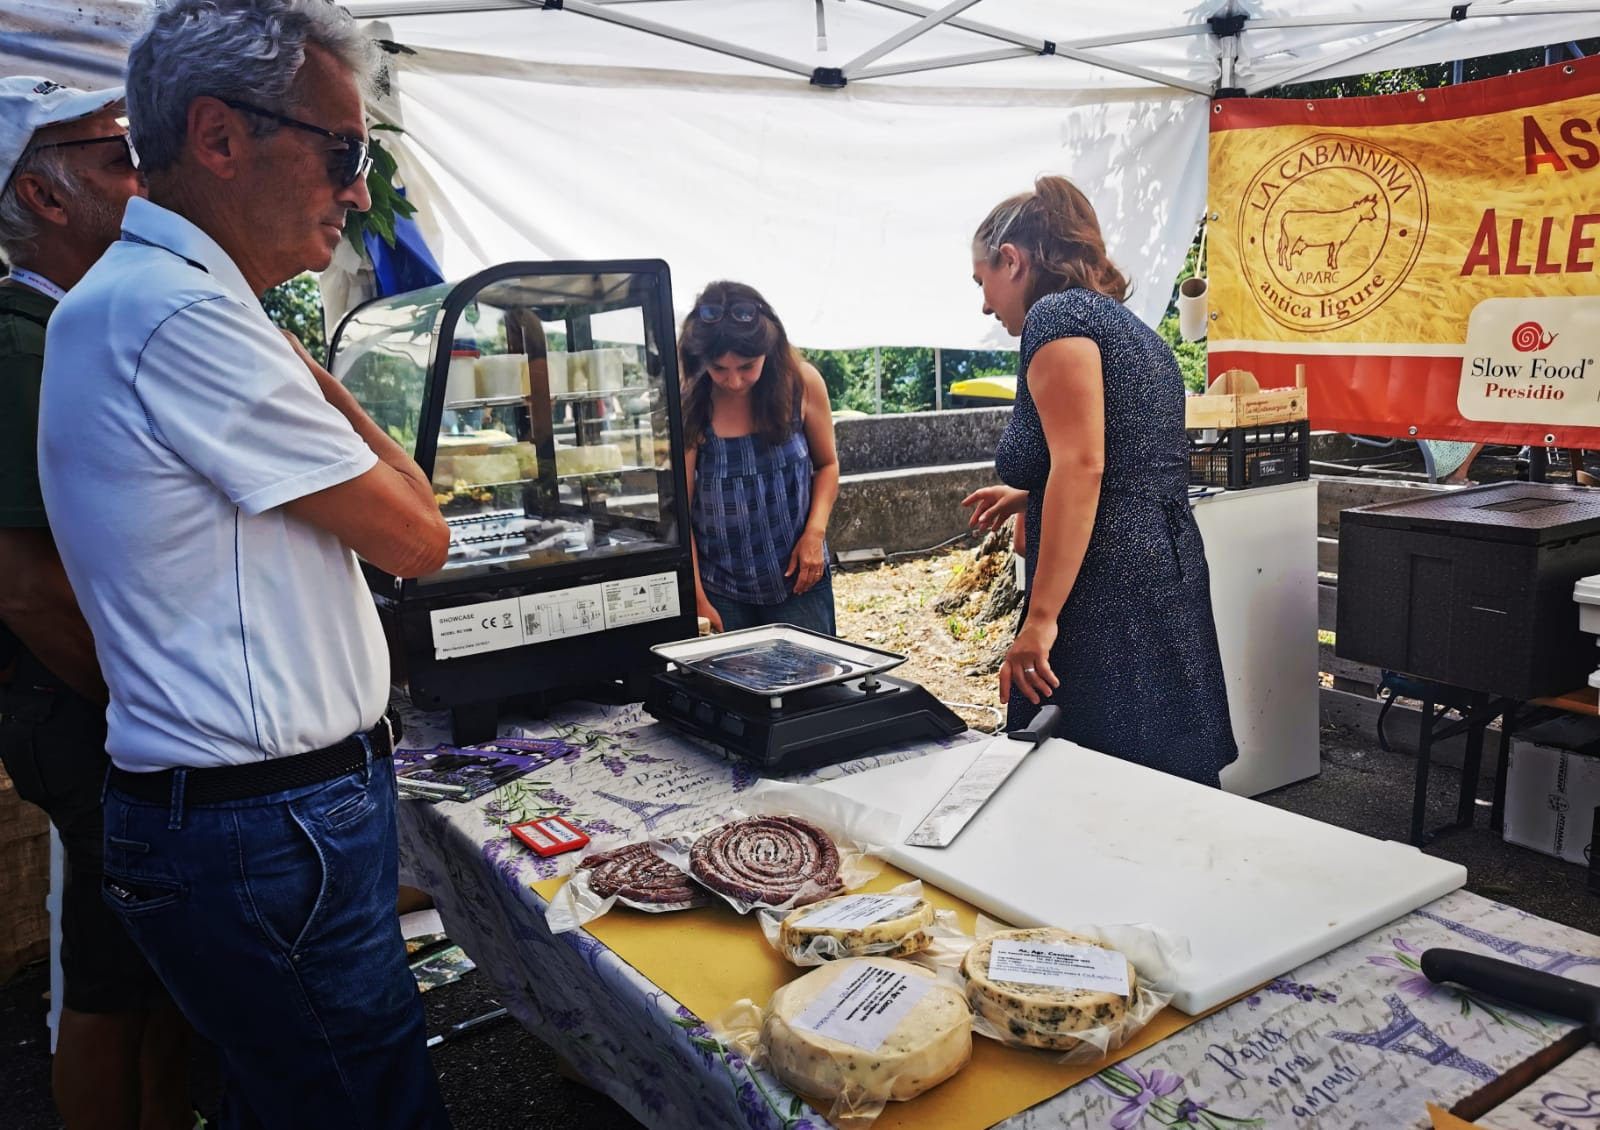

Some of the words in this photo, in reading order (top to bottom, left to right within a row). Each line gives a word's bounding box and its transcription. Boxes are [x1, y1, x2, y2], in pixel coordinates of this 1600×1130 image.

[1523, 115, 1600, 175] AS
[1251, 181, 1280, 211] LA
[1280, 142, 1412, 203] CABANNINA
[1460, 208, 1600, 276] ALLE
[1260, 280, 1312, 319] antica
[1320, 274, 1385, 320] ligure
[1296, 271, 1340, 285] APARC
[1471, 357, 1523, 378] Slow
[1485, 382, 1565, 400] Presidio
[440, 613, 475, 624] SHOWCASE
[1204, 1027, 1289, 1080] Paris
